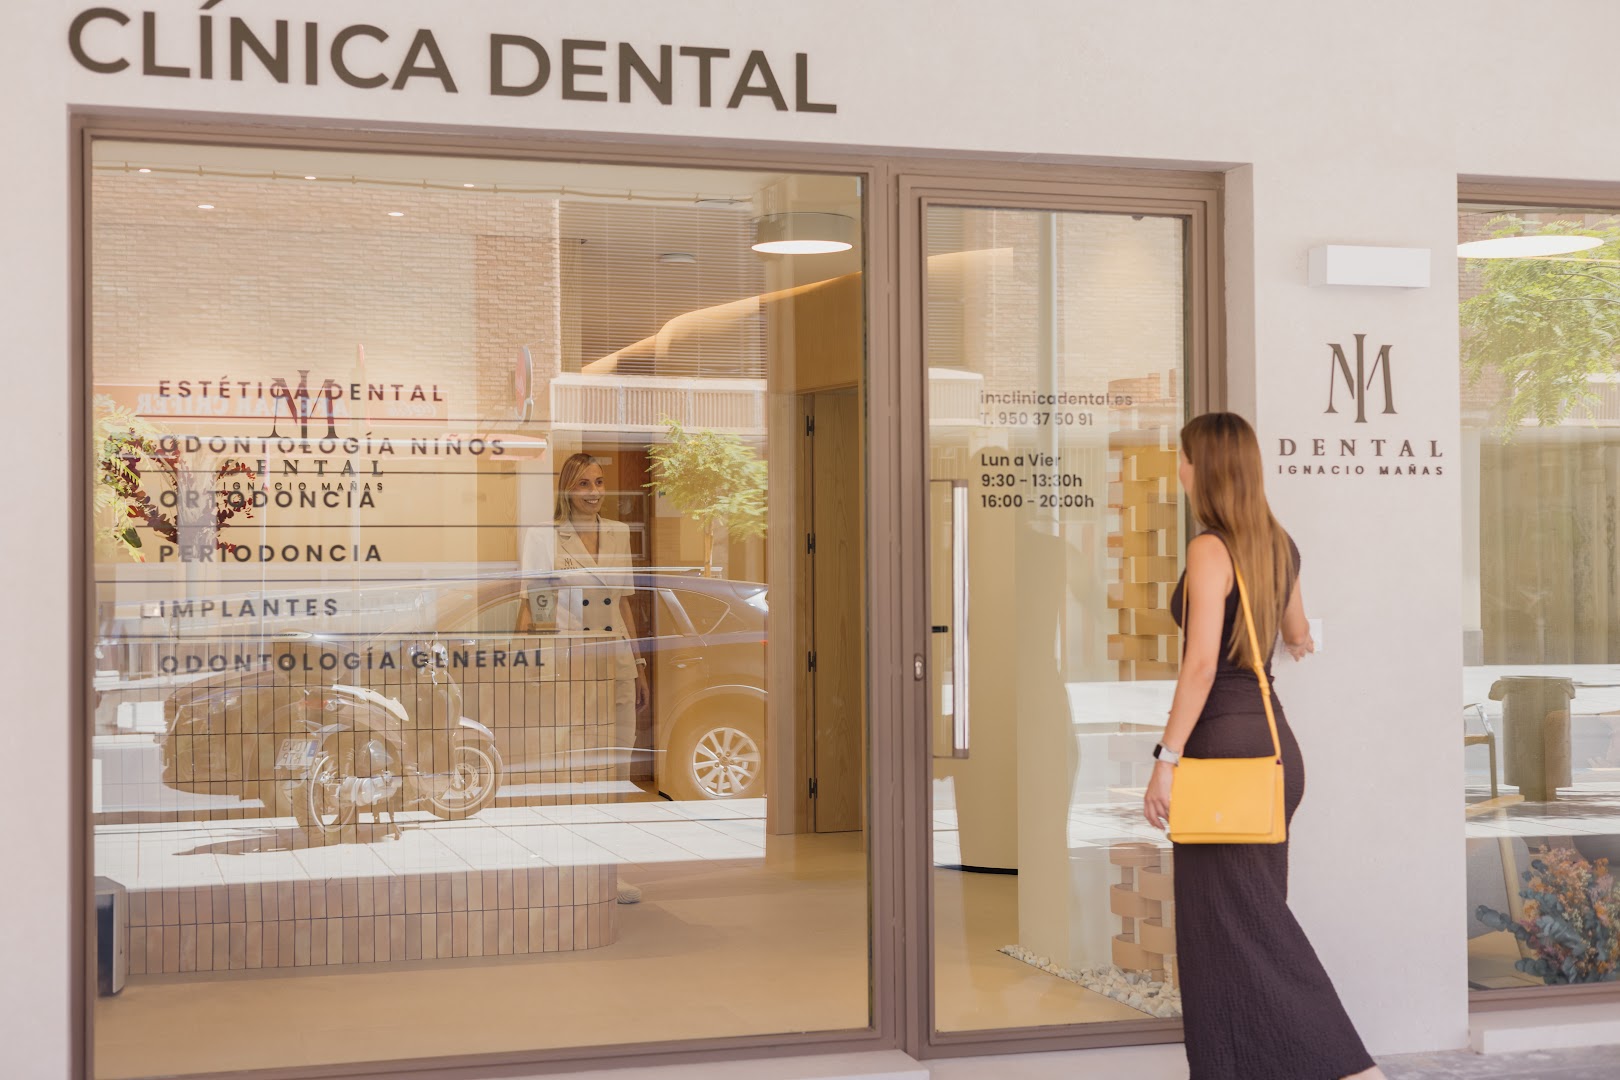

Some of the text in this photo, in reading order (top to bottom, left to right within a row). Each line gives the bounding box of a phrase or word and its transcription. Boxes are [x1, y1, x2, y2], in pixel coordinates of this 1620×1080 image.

[68, 0, 838, 115] CLÍNICA DENTAL
[159, 375, 443, 402] ESTÉTICA DENTAL
[980, 390, 1133, 407] imclinicadental.es
[980, 412, 1094, 426] T. 950 37 50 91
[159, 431, 505, 456] ODONTOLOGÍA NIÑOS
[1278, 438, 1444, 458] DENTAL
[981, 452, 1061, 467] Lun a Vier
[1279, 463, 1443, 475] IGNACIO MAÑAS
[321, 480, 384, 492] MAÑAS
[981, 473, 1016, 488] 9:30
[1032, 473, 1083, 488] 13:30h
[159, 489, 376, 509] ORTODONCIA
[981, 494, 1023, 508] 16:00
[1040, 494, 1094, 508] 20:00h
[159, 544, 382, 563] PERIODONCIA
[161, 598, 338, 618] IMPLANTES
[536, 594, 548, 608] G
[161, 647, 545, 673] ODONTOLOGÍA GENERAL
